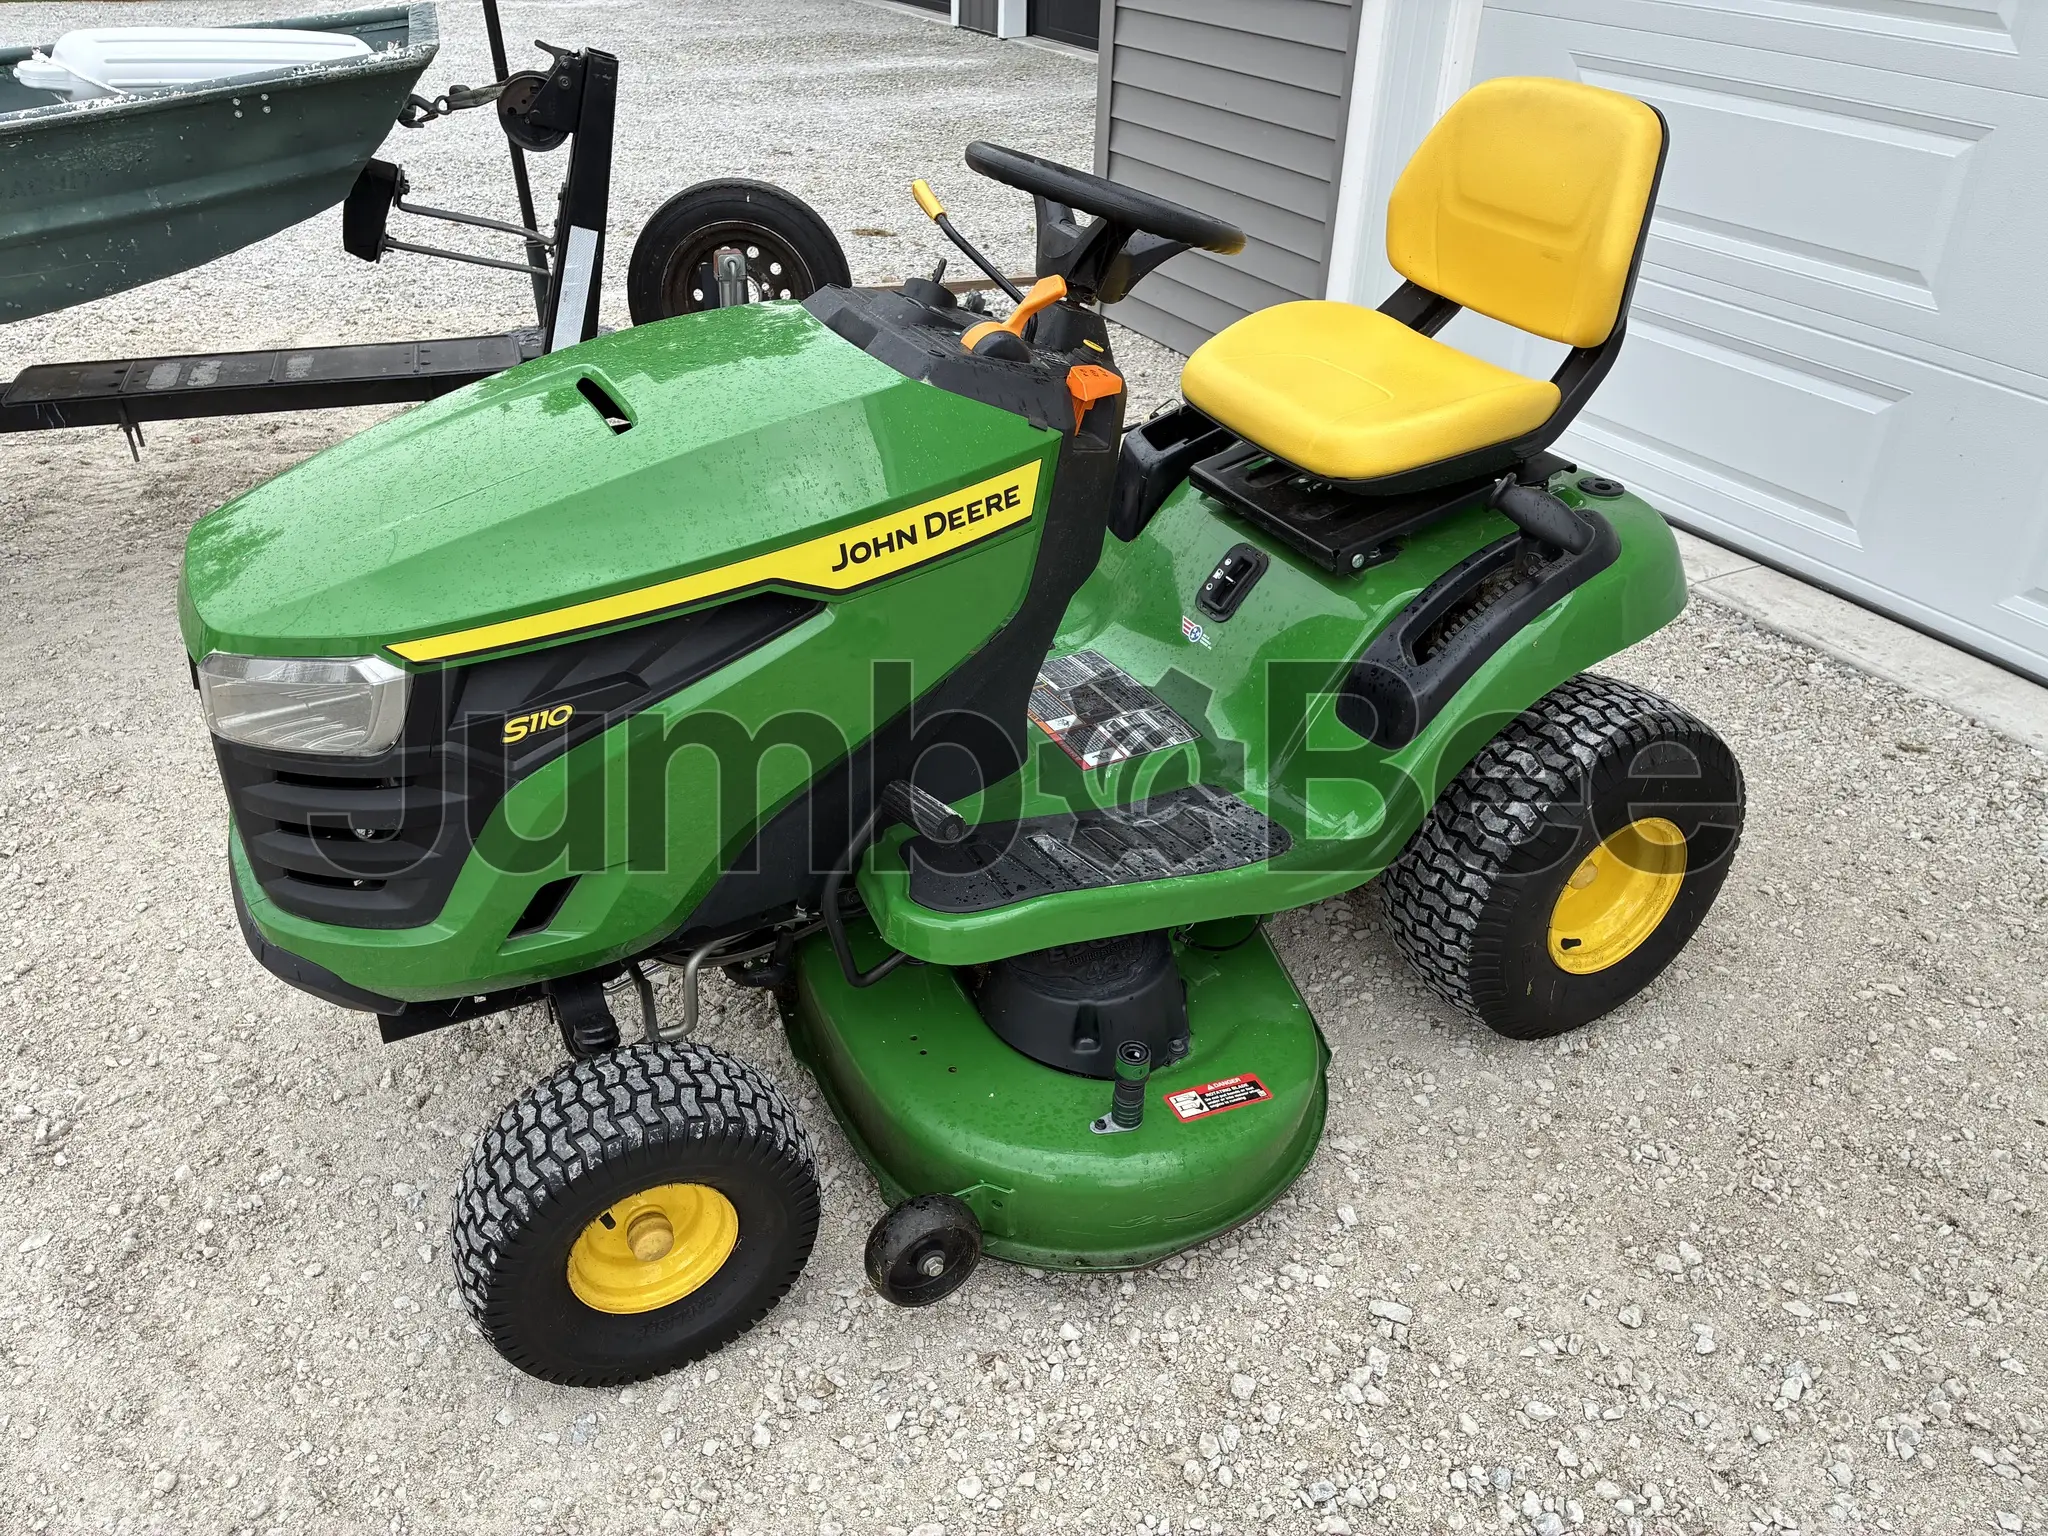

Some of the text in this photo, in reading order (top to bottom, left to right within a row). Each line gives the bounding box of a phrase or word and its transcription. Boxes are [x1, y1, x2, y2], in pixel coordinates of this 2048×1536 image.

[831, 484, 1022, 573] JOHN DEERE
[502, 704, 574, 744] S110
[1213, 1078, 1242, 1088] DANGER
